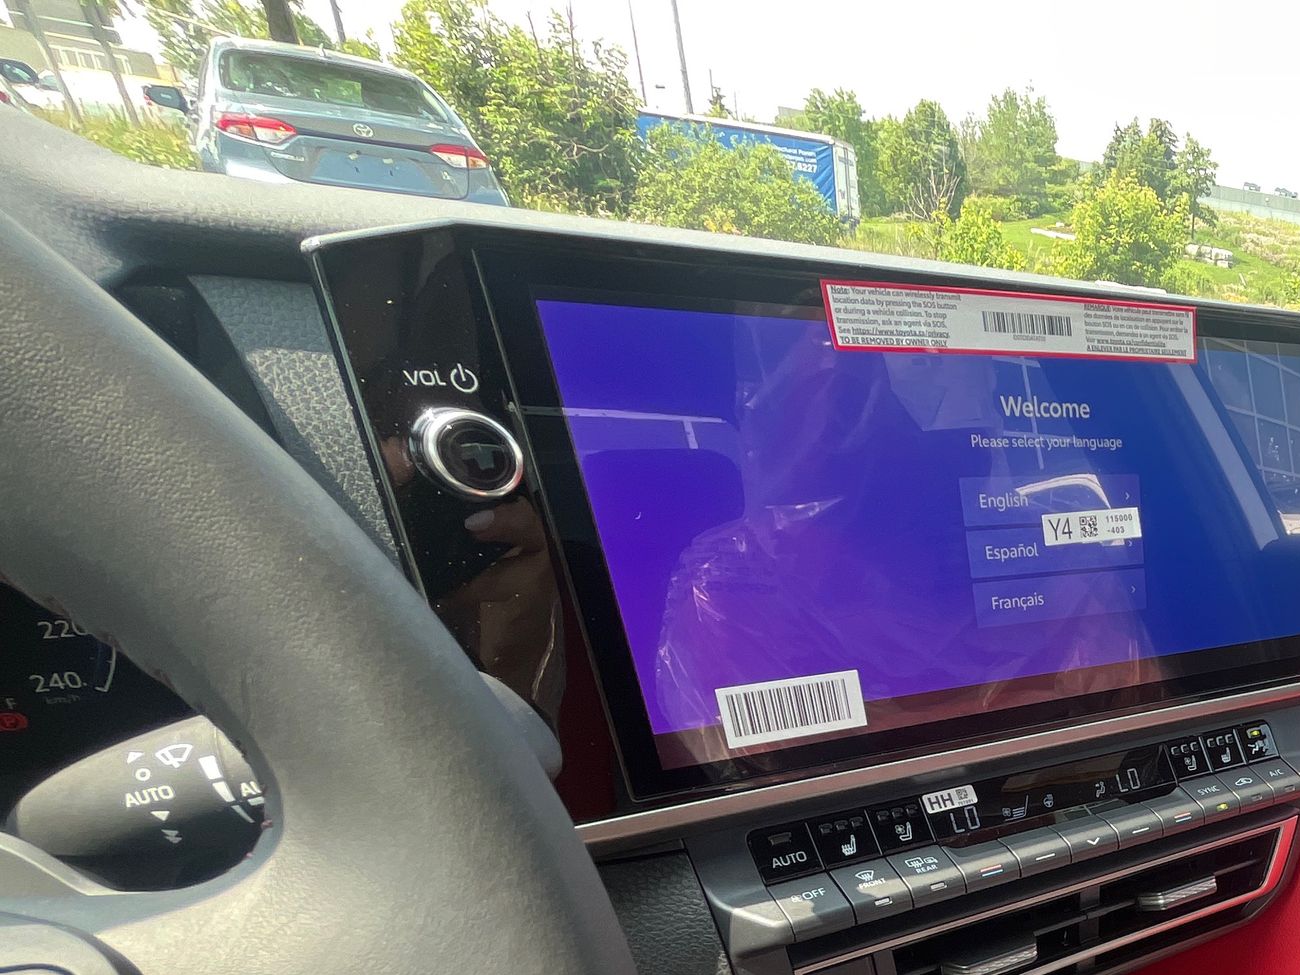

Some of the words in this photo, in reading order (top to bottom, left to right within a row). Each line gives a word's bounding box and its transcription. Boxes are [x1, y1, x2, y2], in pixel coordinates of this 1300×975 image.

[850, 286, 867, 295] Your
[867, 288, 891, 296] vehicle
[904, 290, 935, 300] wirelessly
[832, 295, 860, 304] location
[860, 297, 876, 305] data
[876, 298, 885, 307] by
[886, 300, 912, 309] pressing
[922, 301, 936, 309] SOS
[936, 302, 957, 310] button
[842, 305, 866, 316] during
[872, 308, 895, 316] vehicle
[933, 312, 947, 320] stop
[838, 326, 851, 334] See
[881, 317, 892, 326] ask
[903, 319, 922, 328] agent
[840, 336, 850, 344] TO
[850, 336, 861, 345] BE
[861, 336, 895, 346] REMOVED
[895, 338, 904, 346] BY
[905, 338, 930, 347] OWNER
[930, 339, 948, 348] ONLY
[402, 369, 447, 386] VOL
[1000, 395, 1091, 419] Welcome
[970, 434, 1010, 448] Please
[1011, 435, 1045, 448] select
[1046, 438, 1072, 451] your
[1073, 436, 1123, 451] language
[979, 493, 1028, 512] English
[1105, 513, 1133, 524] 115000
[1048, 517, 1073, 541] Y4
[1107, 526, 1125, 535] -403
[985, 542, 1039, 562] Español
[992, 592, 1045, 611] Français
[1268, 768, 1285, 778] A/C
[124, 784, 175, 808] AUTO
[1197, 785, 1222, 796] SYNC
[927, 792, 957, 812] HH
[771, 851, 808, 869] AUTO
[915, 863, 939, 874] REAR
[858, 877, 887, 889] FRONT
[802, 887, 827, 901] OFF
